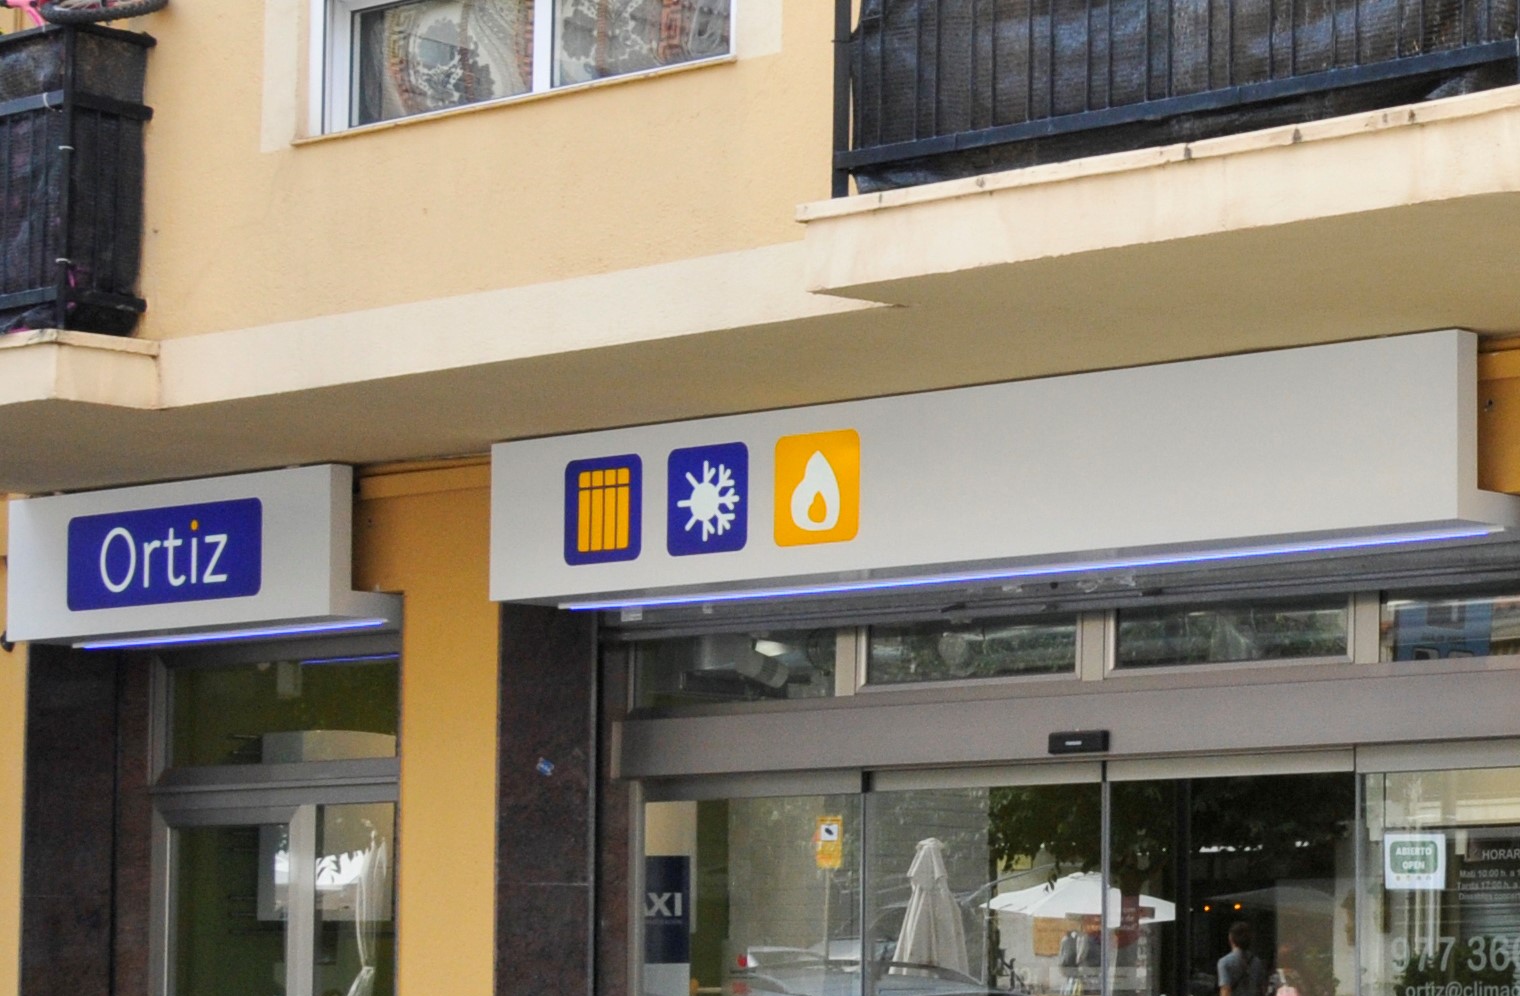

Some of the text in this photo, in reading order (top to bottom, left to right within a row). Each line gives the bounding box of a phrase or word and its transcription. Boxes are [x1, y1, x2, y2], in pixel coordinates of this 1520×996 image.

[100, 519, 228, 593] Ortiz
[1402, 860, 1425, 870] OPEN
[645, 891, 684, 918] XI
[1391, 935, 1456, 971] 977
